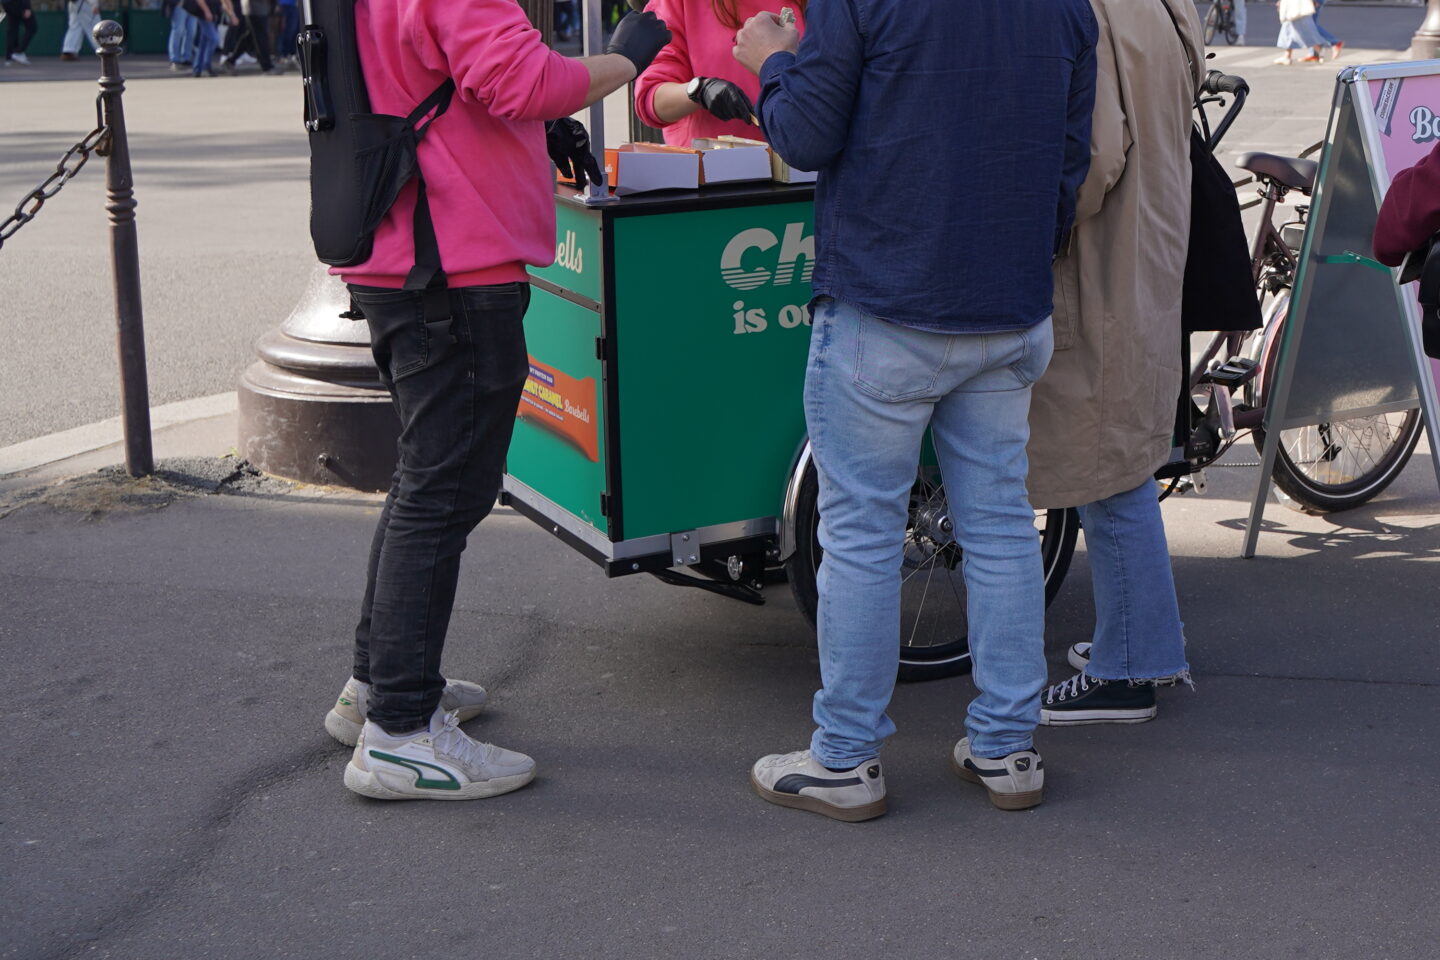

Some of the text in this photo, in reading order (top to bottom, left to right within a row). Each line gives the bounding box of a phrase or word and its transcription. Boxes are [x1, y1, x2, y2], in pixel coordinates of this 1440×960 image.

[556, 230, 583, 274] ells
[732, 300, 768, 334] is
[563, 398, 590, 424] Barebells
